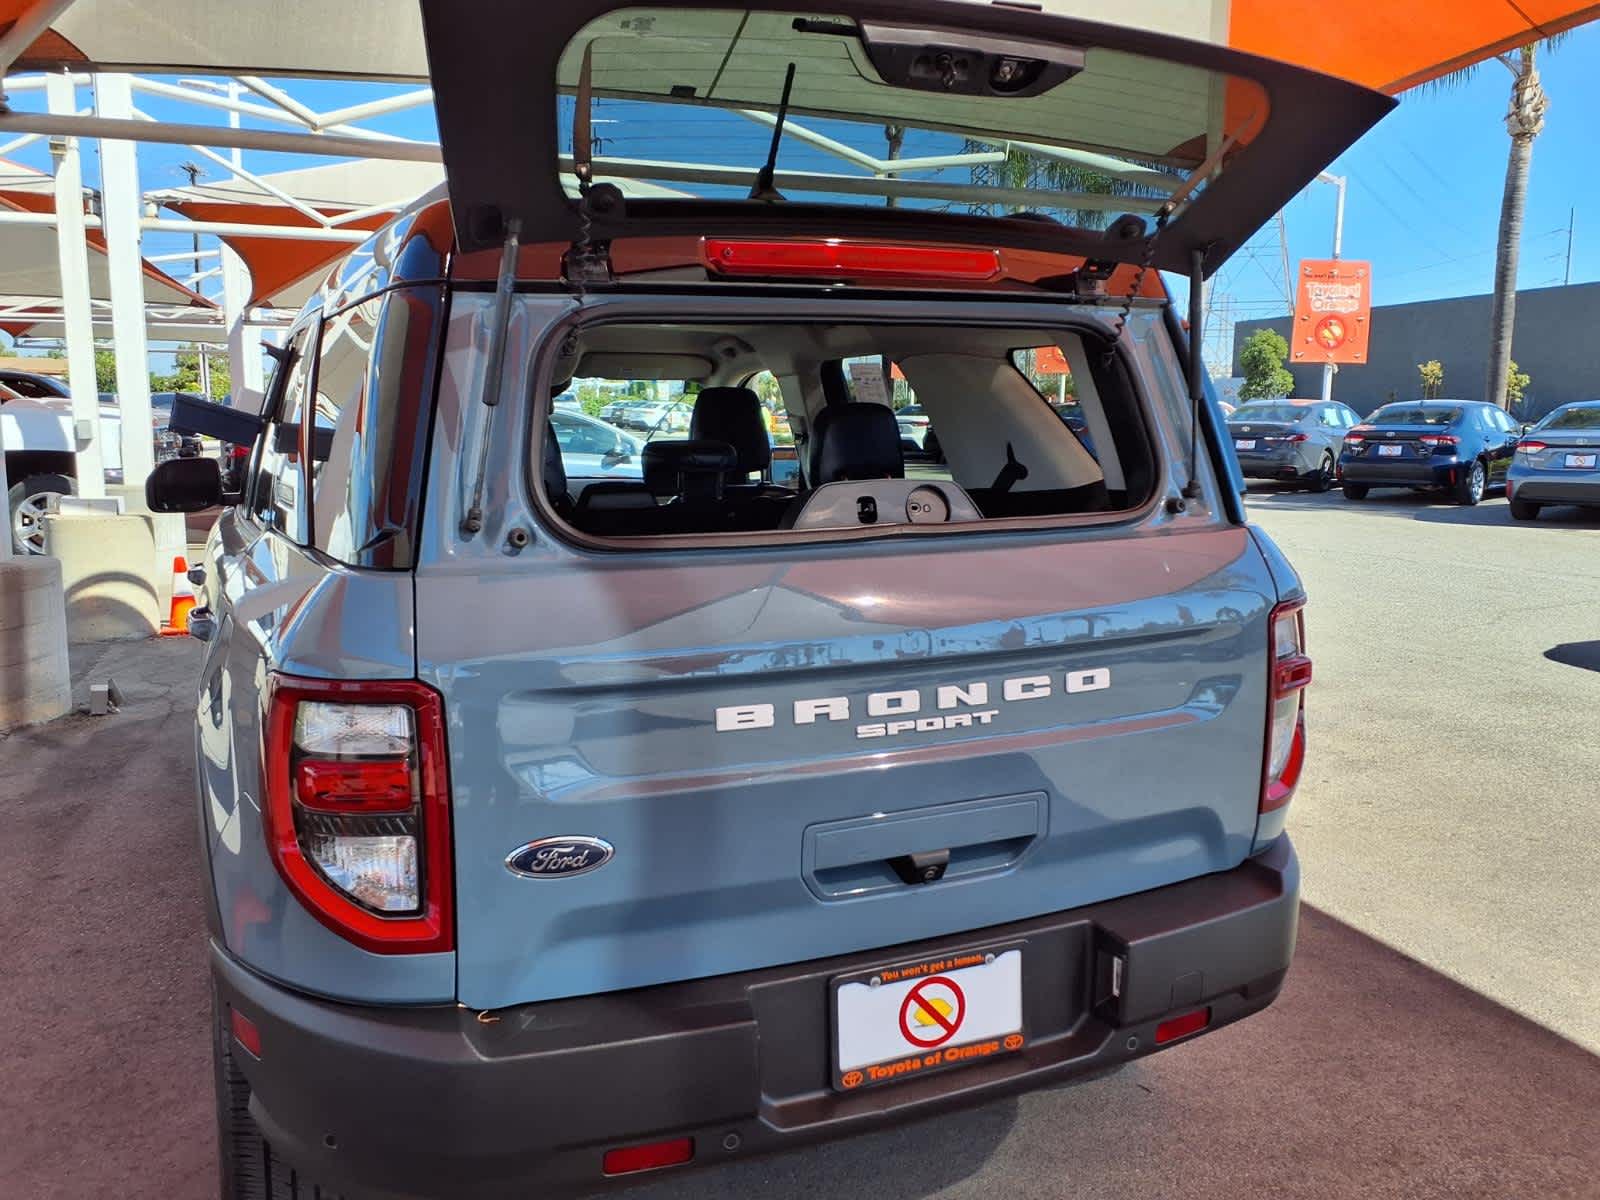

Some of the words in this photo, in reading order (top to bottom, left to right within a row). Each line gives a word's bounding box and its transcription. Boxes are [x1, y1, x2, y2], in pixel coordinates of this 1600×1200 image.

[715, 667, 1111, 732] BRONCO
[856, 709, 999, 738] SPORT
[531, 846, 590, 872] Ford
[881, 968, 899, 981] You
[901, 964, 929, 977] won't
[930, 960, 945, 973] get
[867, 1058, 921, 1079] Toyota
[924, 1051, 942, 1066] of
[944, 1041, 999, 1060] Orange
